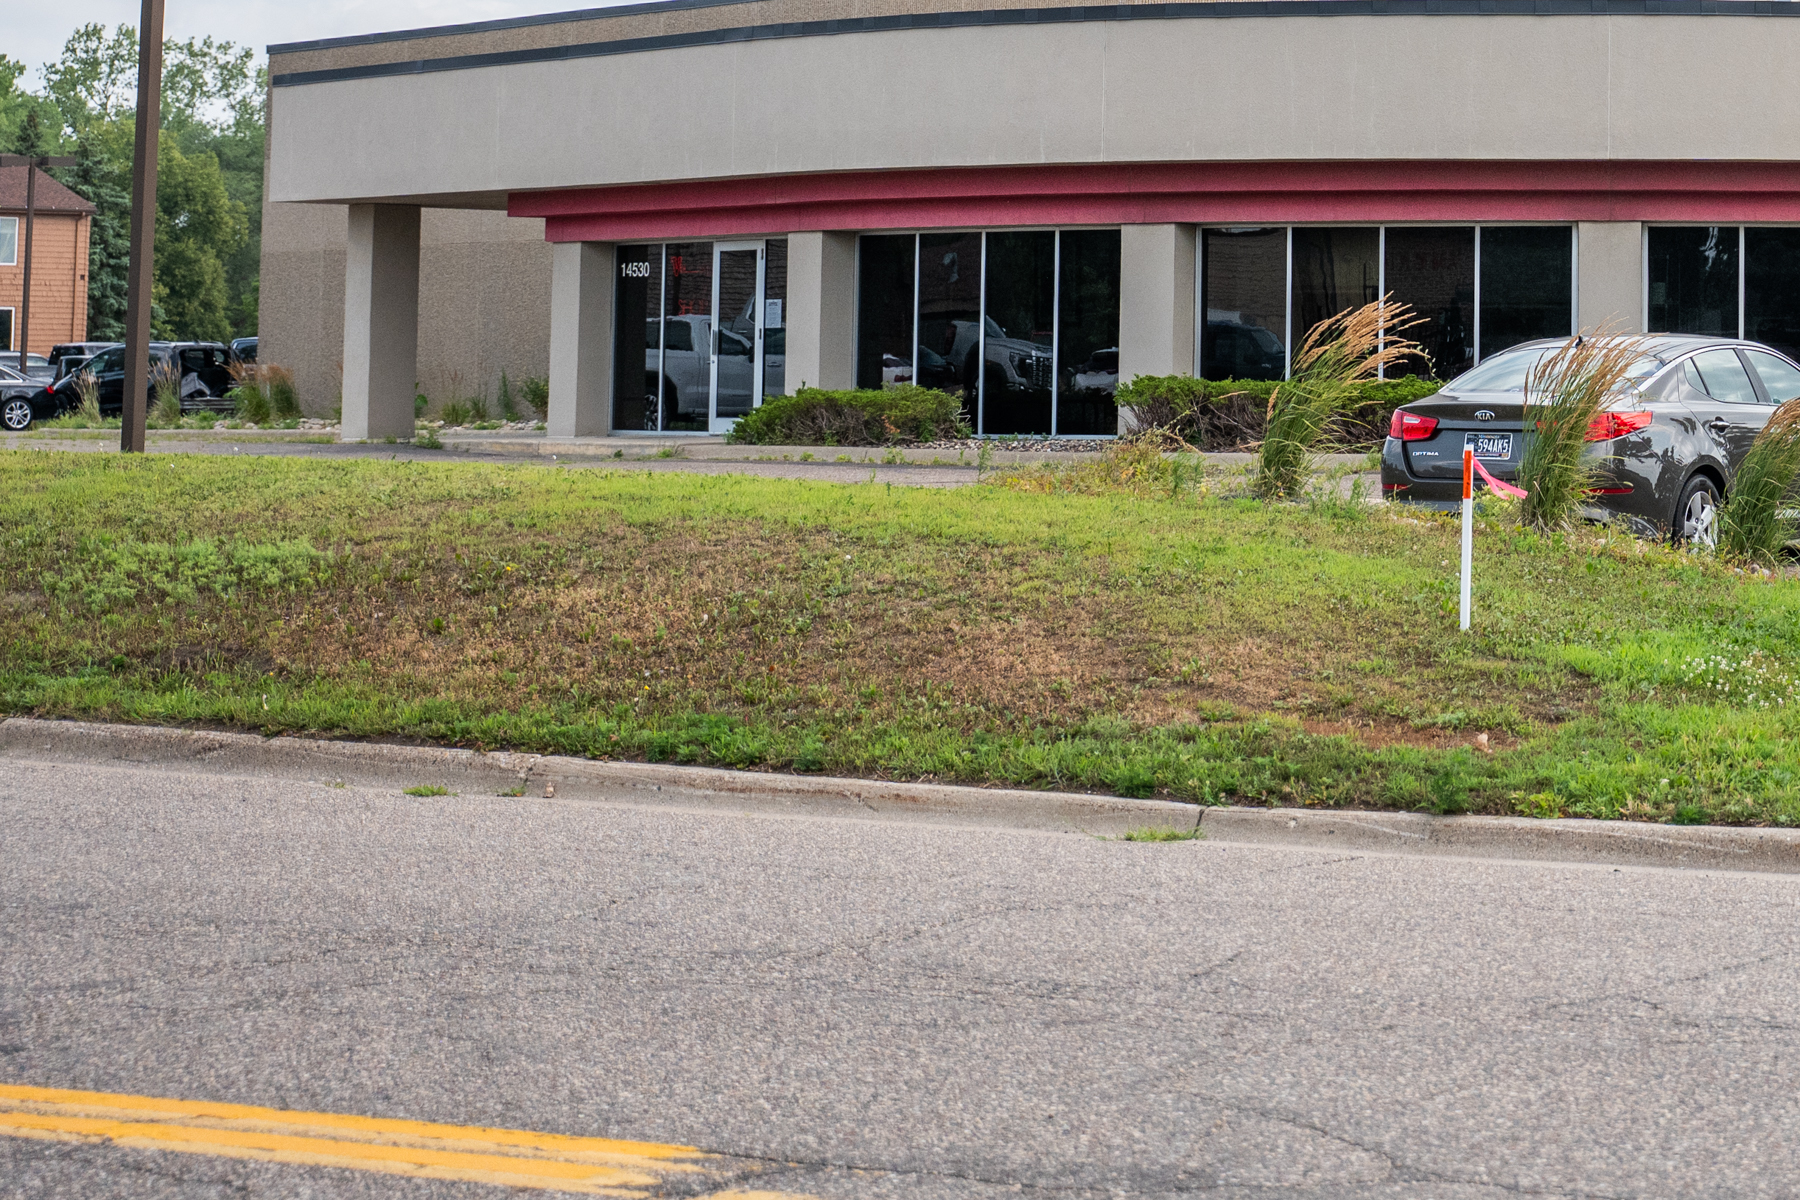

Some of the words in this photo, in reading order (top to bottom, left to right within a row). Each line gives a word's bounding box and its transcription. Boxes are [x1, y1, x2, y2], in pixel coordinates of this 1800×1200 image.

[621, 262, 650, 277] 14530
[1476, 412, 1492, 421] KIA
[1478, 439, 1509, 453] 594AK5
